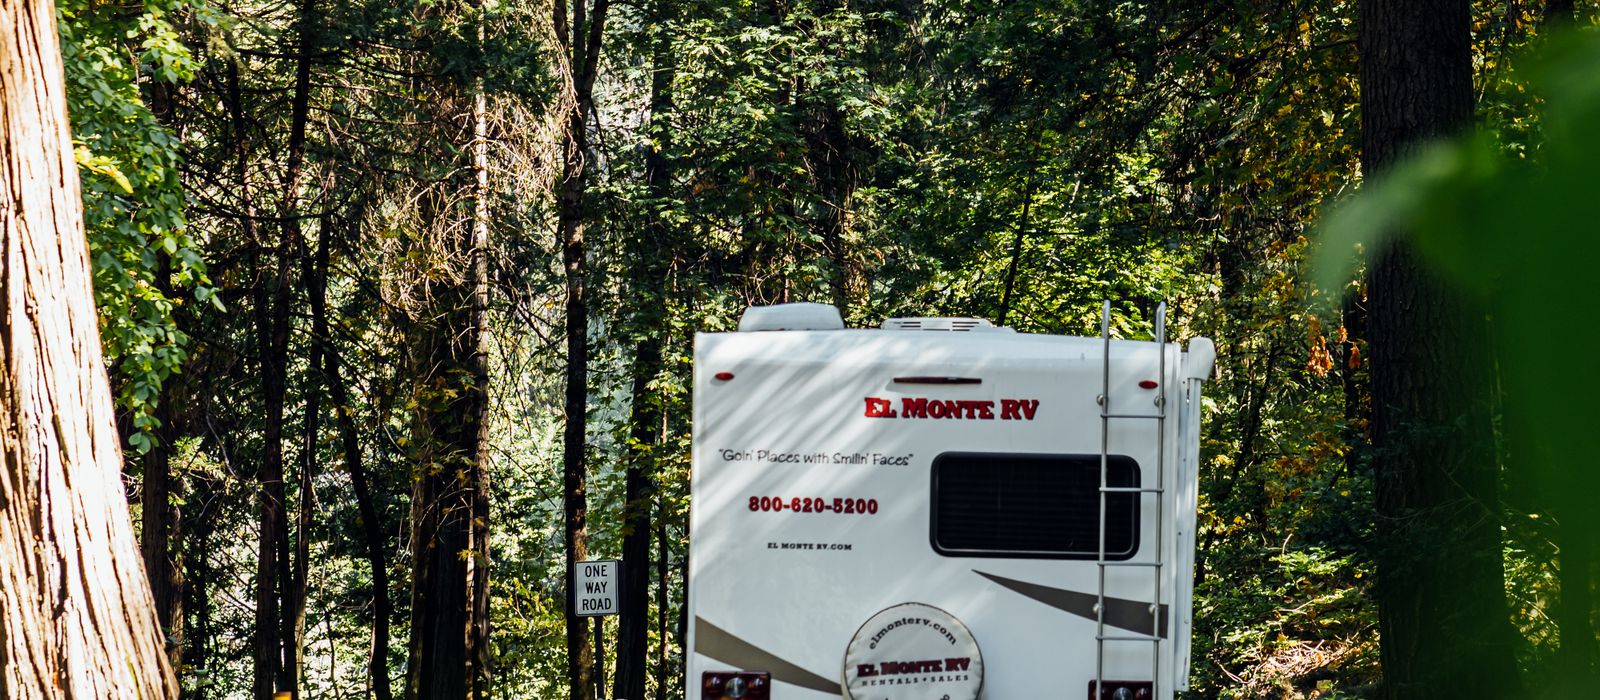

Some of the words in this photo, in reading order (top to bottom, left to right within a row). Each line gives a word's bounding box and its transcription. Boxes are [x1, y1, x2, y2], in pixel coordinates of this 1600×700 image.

[1000, 399, 1039, 420] RV
[757, 450, 800, 463] Places
[803, 453, 830, 464] with
[748, 496, 878, 514] 800-620-5200
[585, 565, 608, 577] ONE
[585, 581, 608, 594] WAY
[582, 598, 612, 611] ROAD
[869, 617, 957, 650] elmonterv.com
[944, 657, 971, 672] RV
[862, 677, 919, 687] RENTALS
[930, 674, 969, 683] SALES
